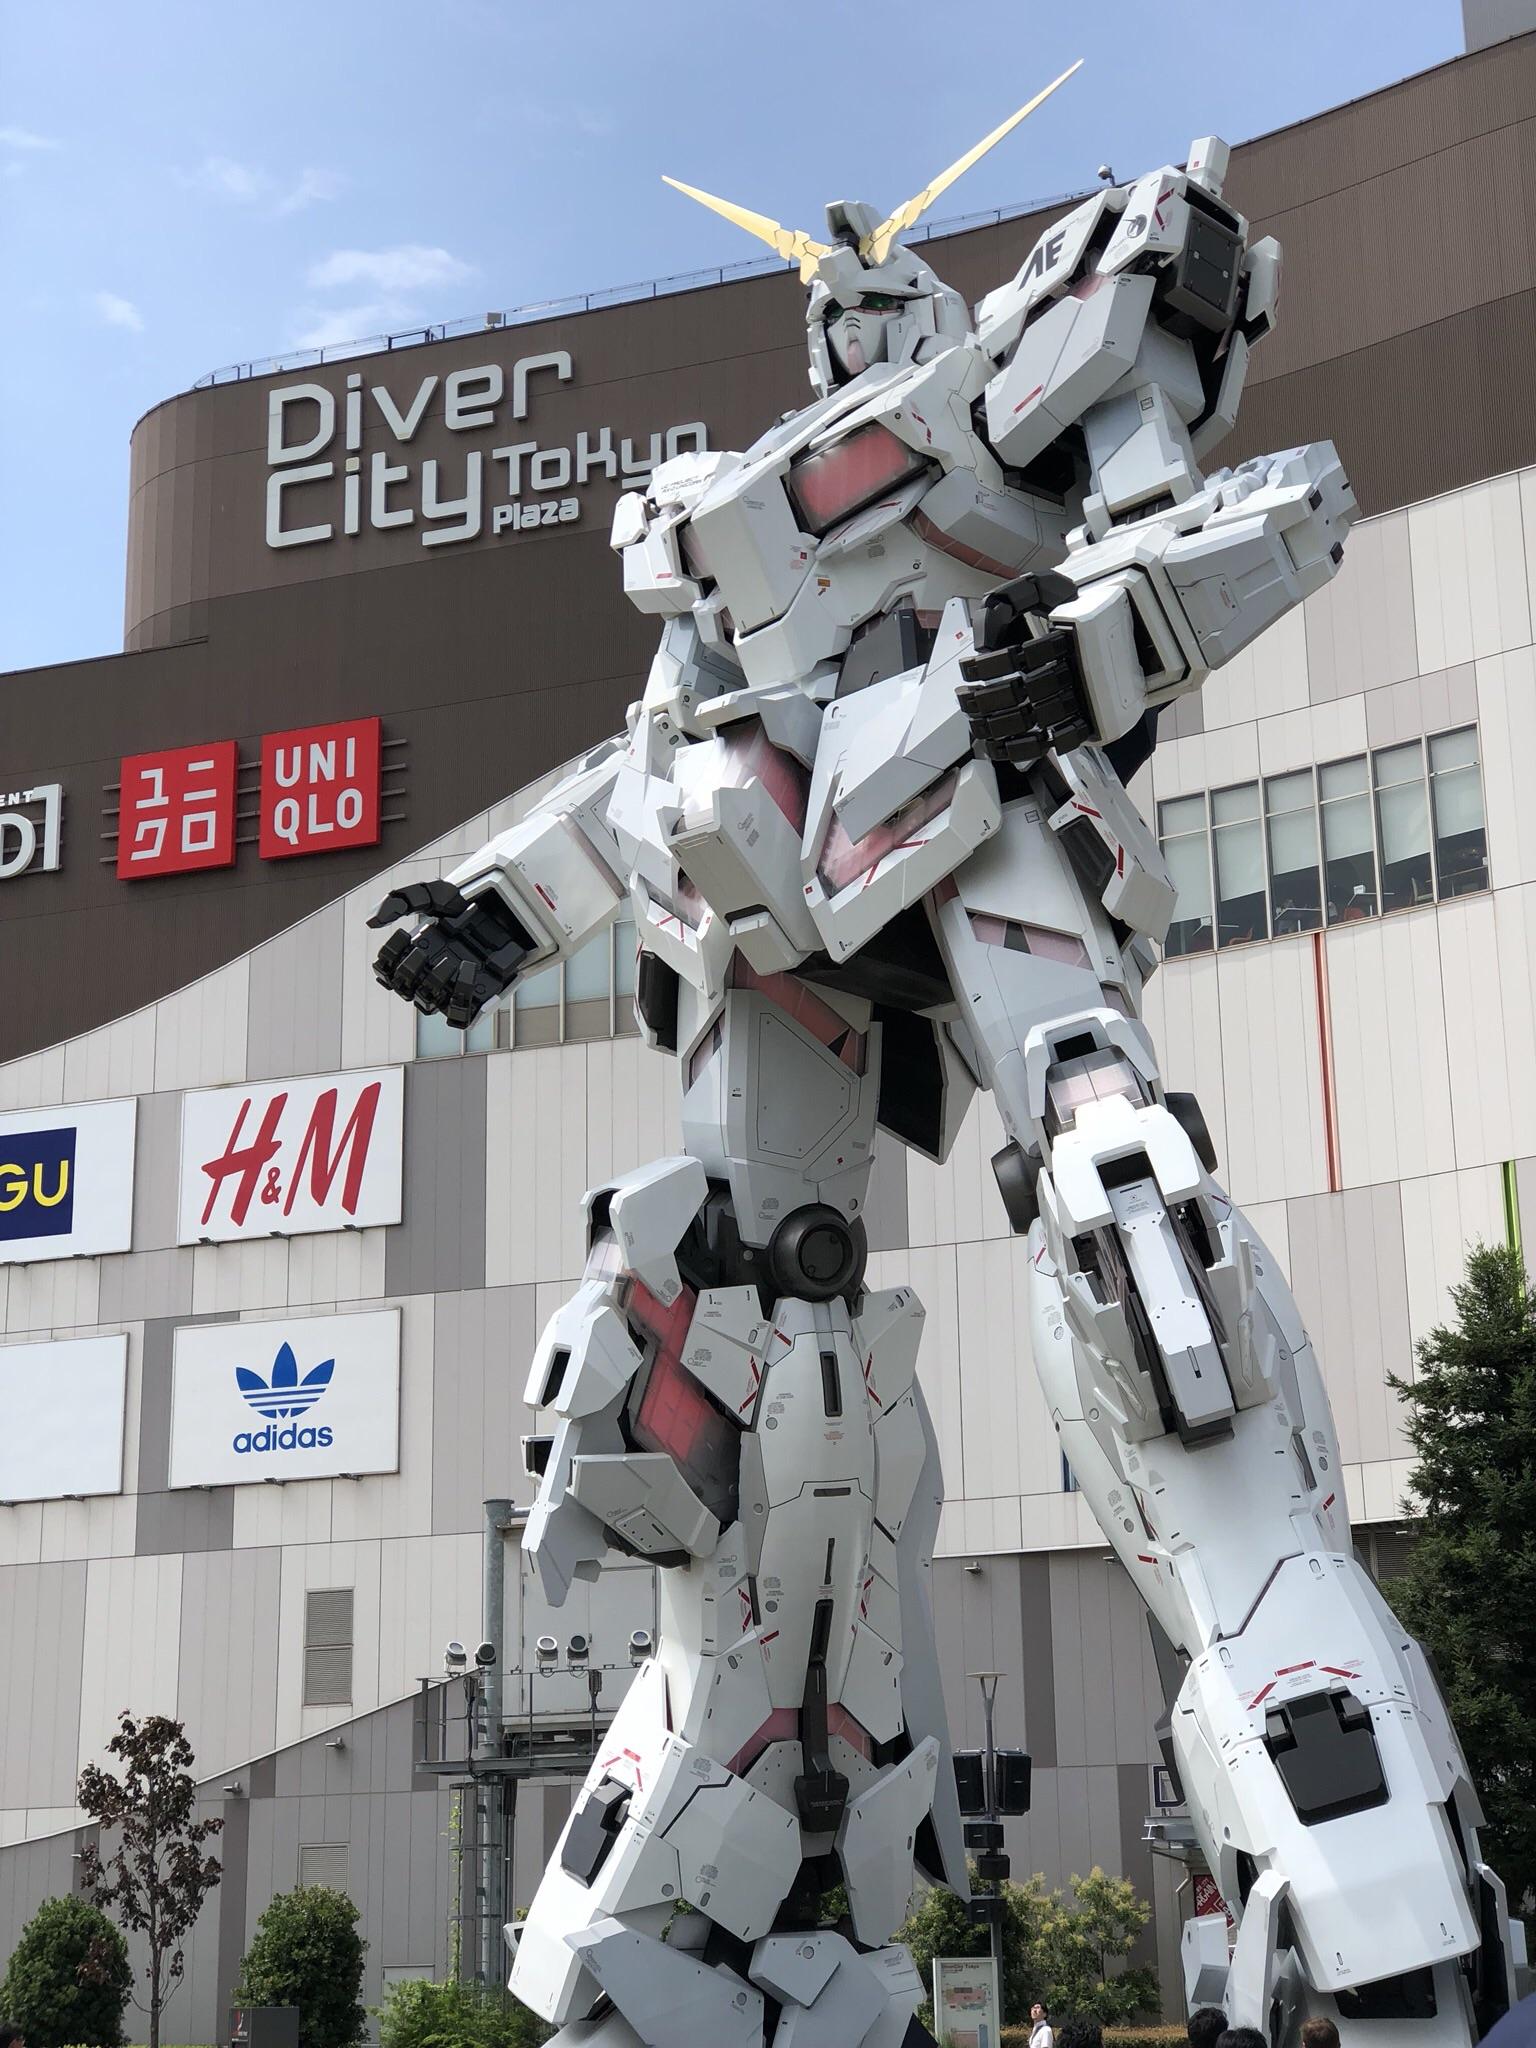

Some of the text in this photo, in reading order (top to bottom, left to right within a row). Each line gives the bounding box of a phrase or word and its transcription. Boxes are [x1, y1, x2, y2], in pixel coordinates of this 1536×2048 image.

[267, 350, 574, 465] Diver
[266, 421, 708, 548] City Tokyo
[493, 496, 580, 534] Plaza
[135, 759, 217, 809] ユニ
[275, 737, 356, 788] UNI
[130, 810, 216, 861] クロ
[274, 788, 363, 845] QLO
[201, 1082, 381, 1227] H&M
[0, 1159, 69, 1212] GU
[232, 1423, 334, 1455] adidas
